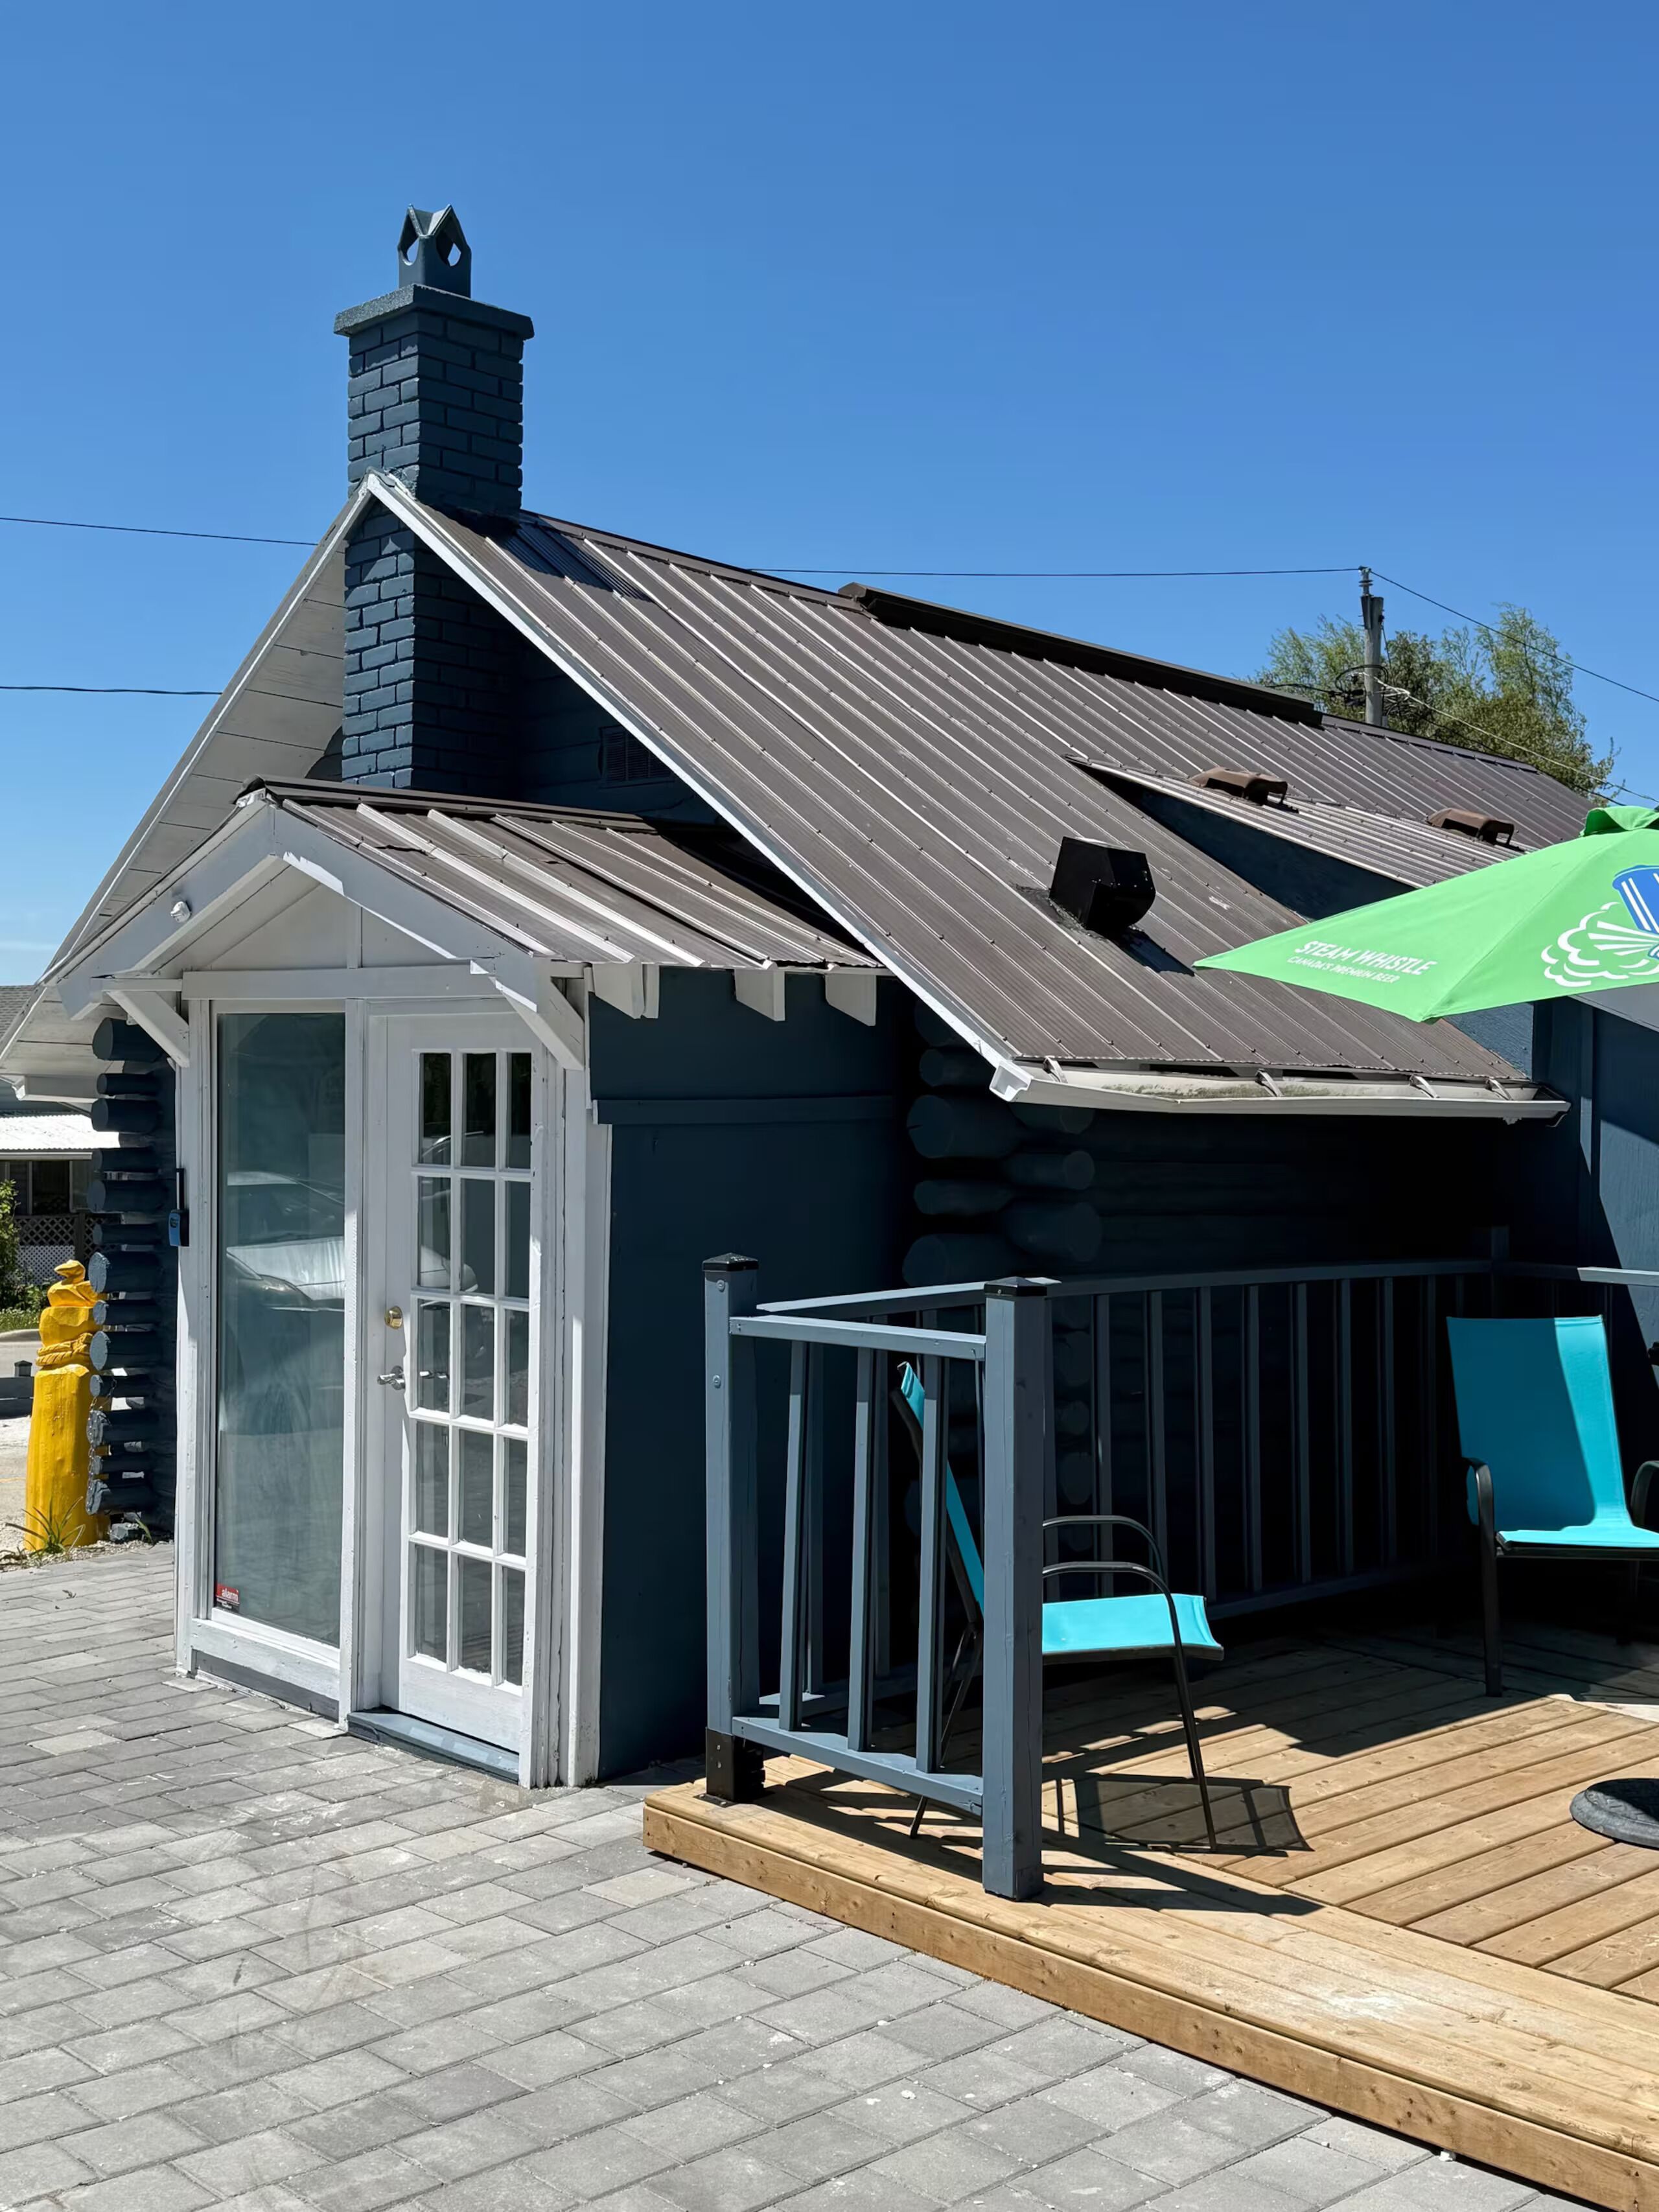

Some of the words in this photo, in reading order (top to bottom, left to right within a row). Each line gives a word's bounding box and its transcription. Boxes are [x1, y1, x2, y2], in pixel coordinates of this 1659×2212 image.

[1286, 956, 1334, 970] CANADA'S
[1371, 972, 1400, 984] BEER
[1294, 940, 1361, 962] STEAM
[1351, 949, 1437, 975] WHISTLE
[221, 1587, 238, 1603] alarm
